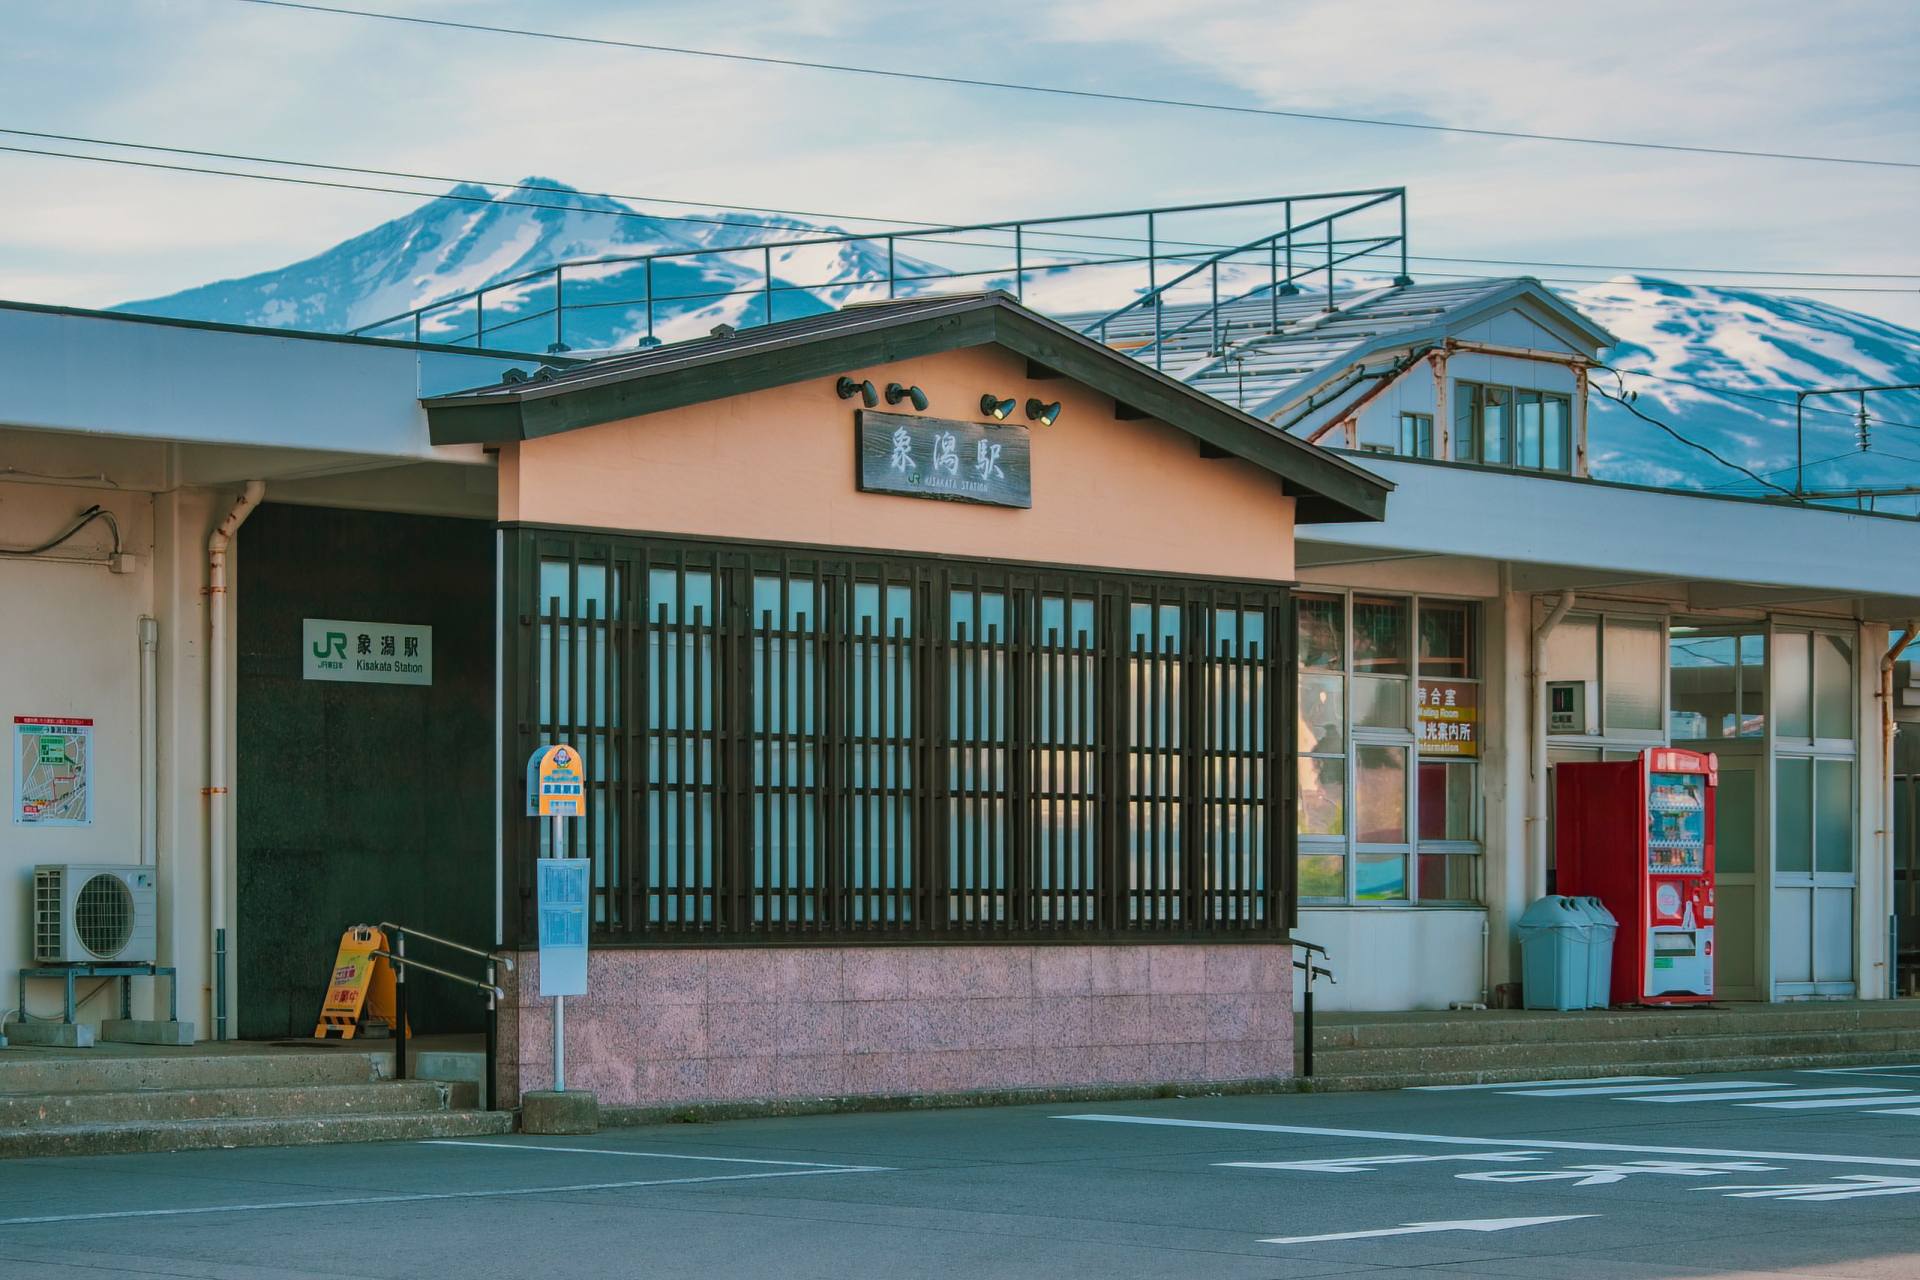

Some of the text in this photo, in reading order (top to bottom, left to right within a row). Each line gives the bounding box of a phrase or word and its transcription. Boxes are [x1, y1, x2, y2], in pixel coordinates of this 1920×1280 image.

[891, 426, 1004, 480] 象潟駅
[908, 473, 920, 484] JR
[924, 476, 989, 493] KISAKATA STATION
[313, 632, 347, 660] JR
[357, 633, 419, 658] 象潟駅
[318, 661, 343, 670] JR東日本
[356, 659, 423, 674] Kisakata Station
[1440, 708, 1459, 718] Room
[1418, 742, 1459, 752] nformation
